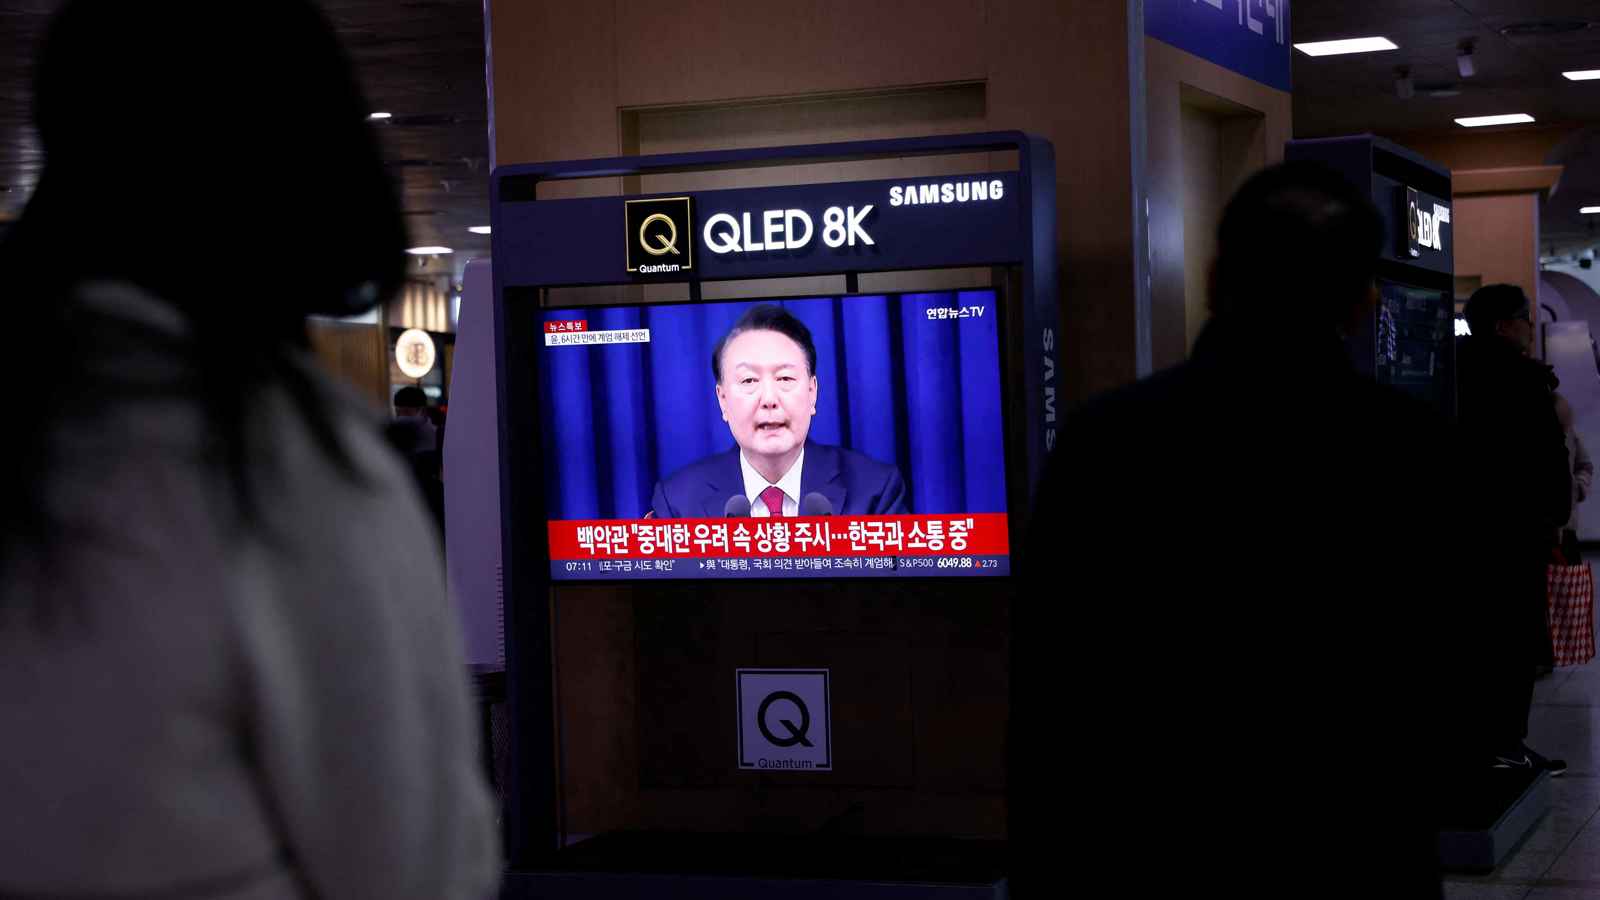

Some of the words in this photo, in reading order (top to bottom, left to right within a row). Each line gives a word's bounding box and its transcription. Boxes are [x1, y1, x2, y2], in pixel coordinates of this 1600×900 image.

[889, 180, 1004, 206] SAMSUNG
[639, 213, 681, 256] Q
[703, 208, 814, 254] QLED
[822, 204, 875, 248] 8K
[639, 263, 680, 273] Quantum
[926, 306, 985, 320] 연합뉴스TV
[549, 321, 583, 333] 뉴스특보
[561, 334, 581, 344] 6시간
[631, 330, 646, 341] 선언
[576, 525, 629, 555] 백악관
[631, 523, 691, 554] "중대한
[693, 523, 729, 554] 우려
[732, 523, 751, 553] 속
[753, 522, 791, 553] 상황
[907, 519, 946, 551] 소통
[948, 518, 974, 551] 중"
[566, 562, 592, 571] 07:11
[634, 560, 653, 571] 시도
[655, 559, 675, 571] 확인"
[753, 558, 772, 570] 국회
[774, 558, 792, 570] 의견
[795, 558, 832, 570] 받아들여
[834, 557, 863, 569] 조속히
[899, 558, 934, 568] S&P500
[937, 557, 972, 568] 6049.88
[982, 559, 998, 568] 2.73
[758, 691, 813, 746] Q
[758, 758, 812, 768] Quantum
